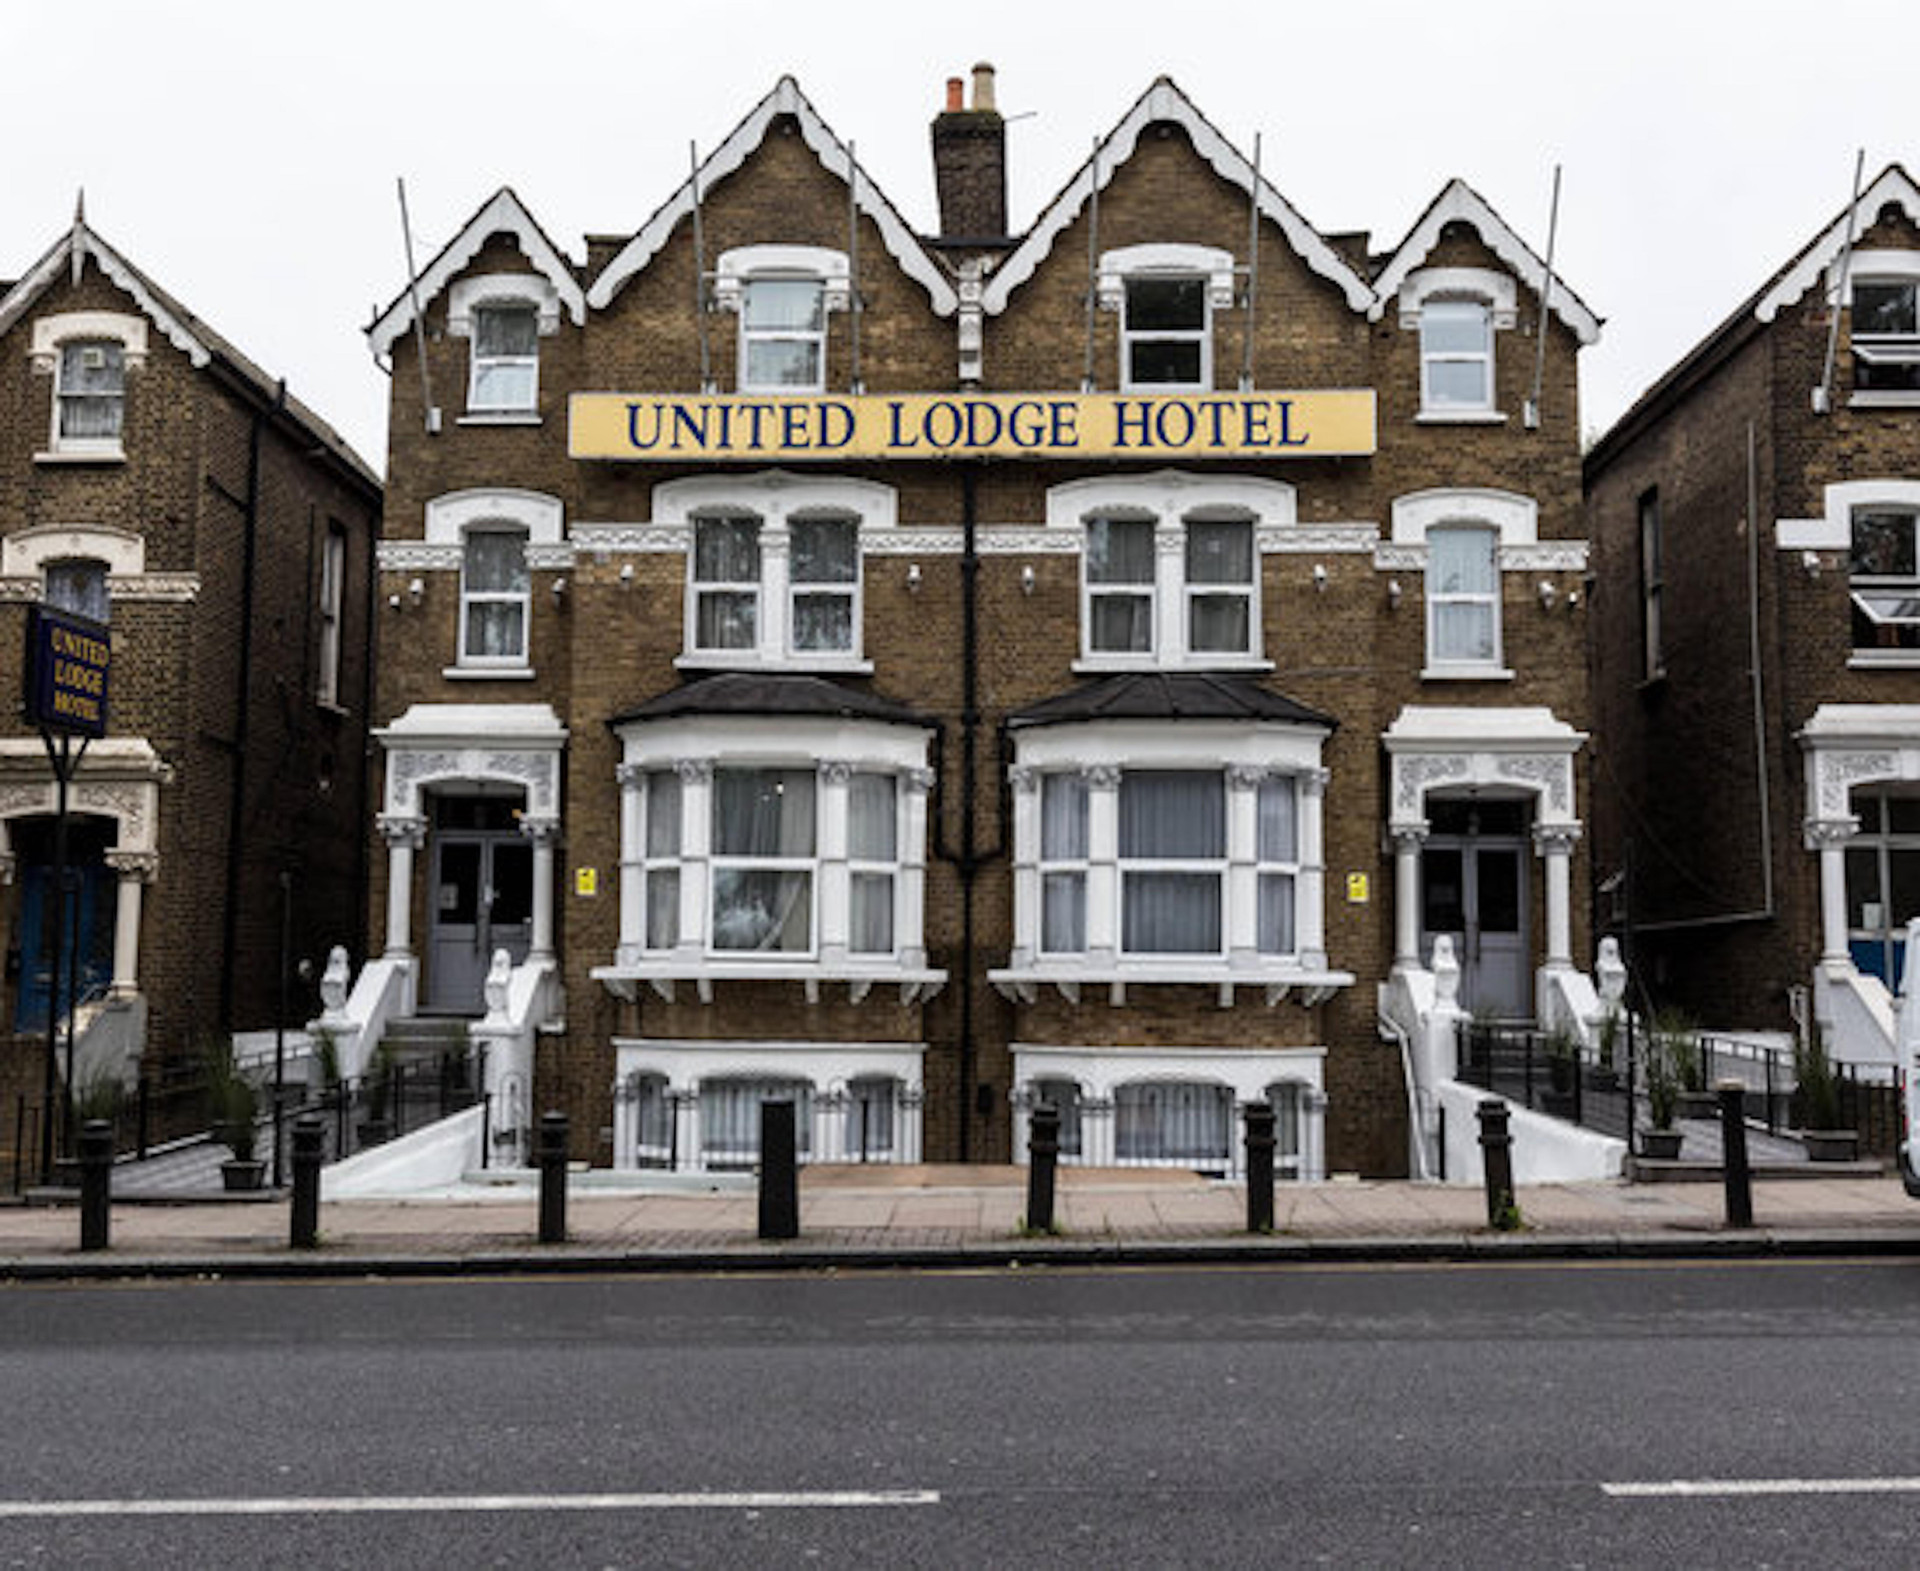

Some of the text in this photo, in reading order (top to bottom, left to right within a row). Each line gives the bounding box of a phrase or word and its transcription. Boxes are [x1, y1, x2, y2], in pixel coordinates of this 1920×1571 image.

[625, 400, 1310, 449] UNITED LODGE HOTEL
[51, 626, 109, 667] UNITED
[54, 658, 103, 696] LODGE
